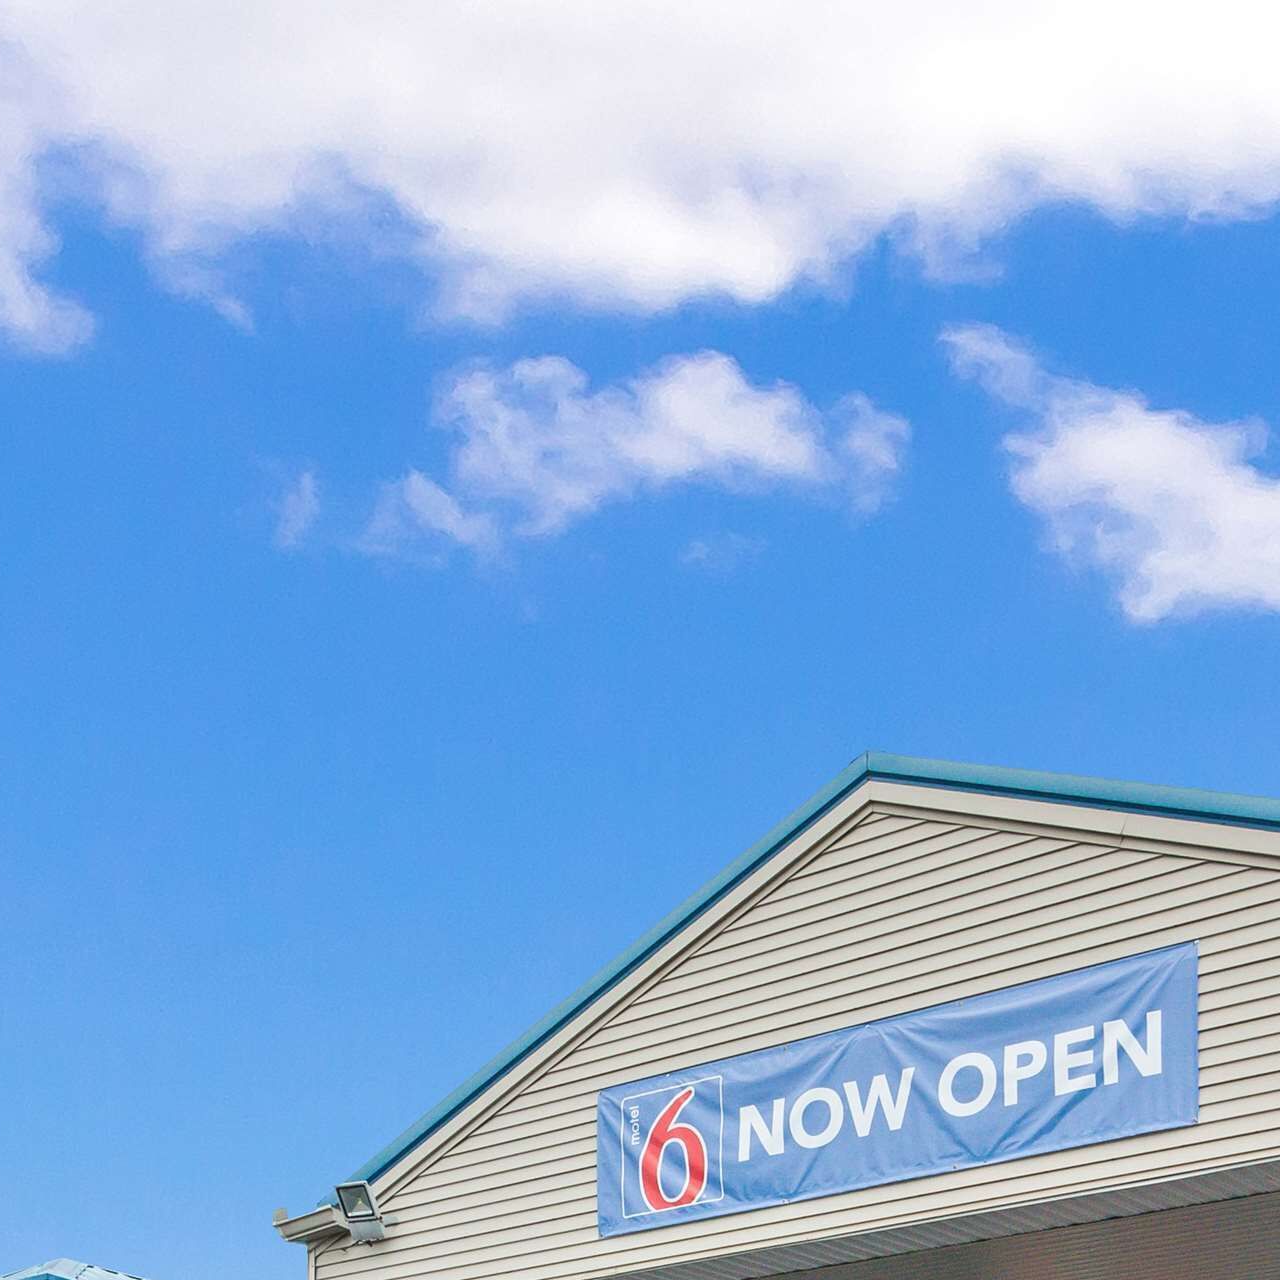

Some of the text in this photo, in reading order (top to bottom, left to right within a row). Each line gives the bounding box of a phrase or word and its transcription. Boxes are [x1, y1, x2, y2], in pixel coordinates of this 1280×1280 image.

[629, 1105, 640, 1146] motel
[639, 1086, 708, 1212] 6
[737, 1010, 1163, 1162] NOW OPEN
